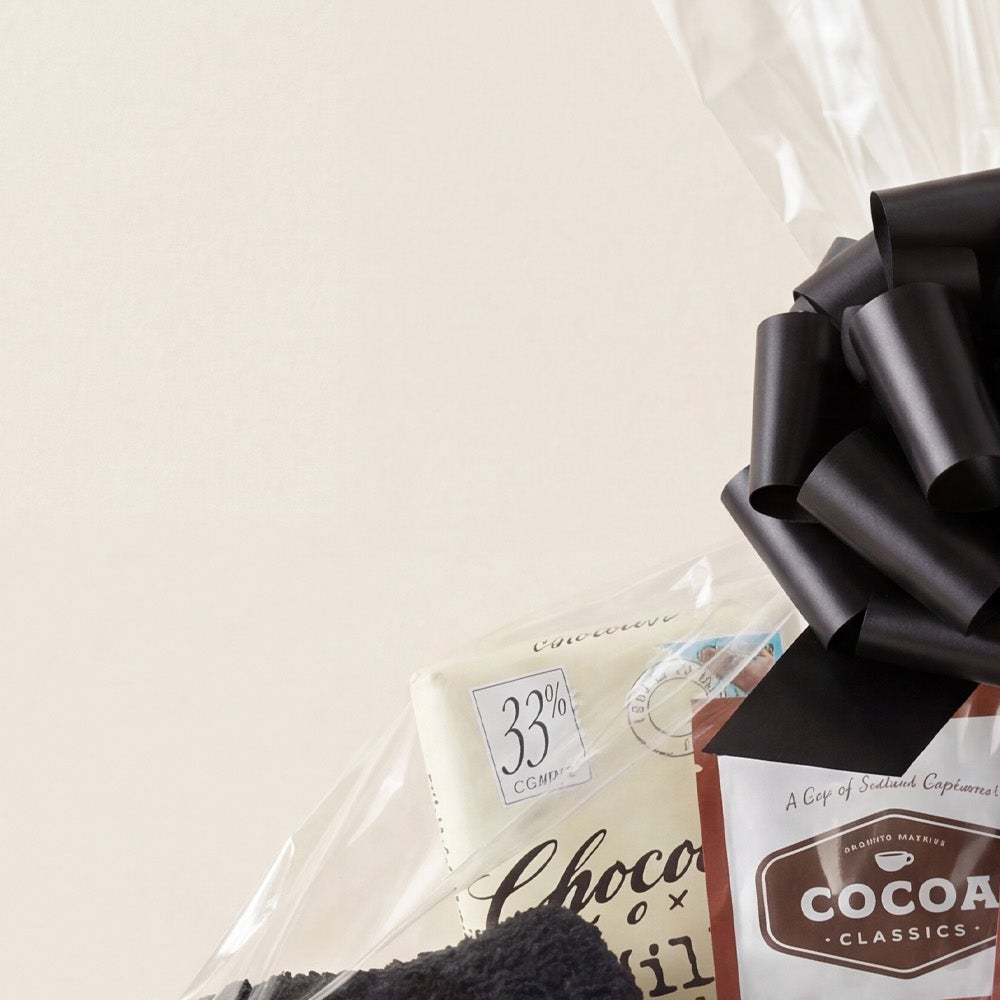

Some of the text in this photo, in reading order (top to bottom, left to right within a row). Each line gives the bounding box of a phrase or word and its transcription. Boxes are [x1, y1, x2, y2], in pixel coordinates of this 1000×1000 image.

[502, 681, 567, 775] 33%
[468, 829, 707, 929] Choco
[800, 875, 1000, 922] COCOA
[839, 923, 967, 946] CLASSICS
